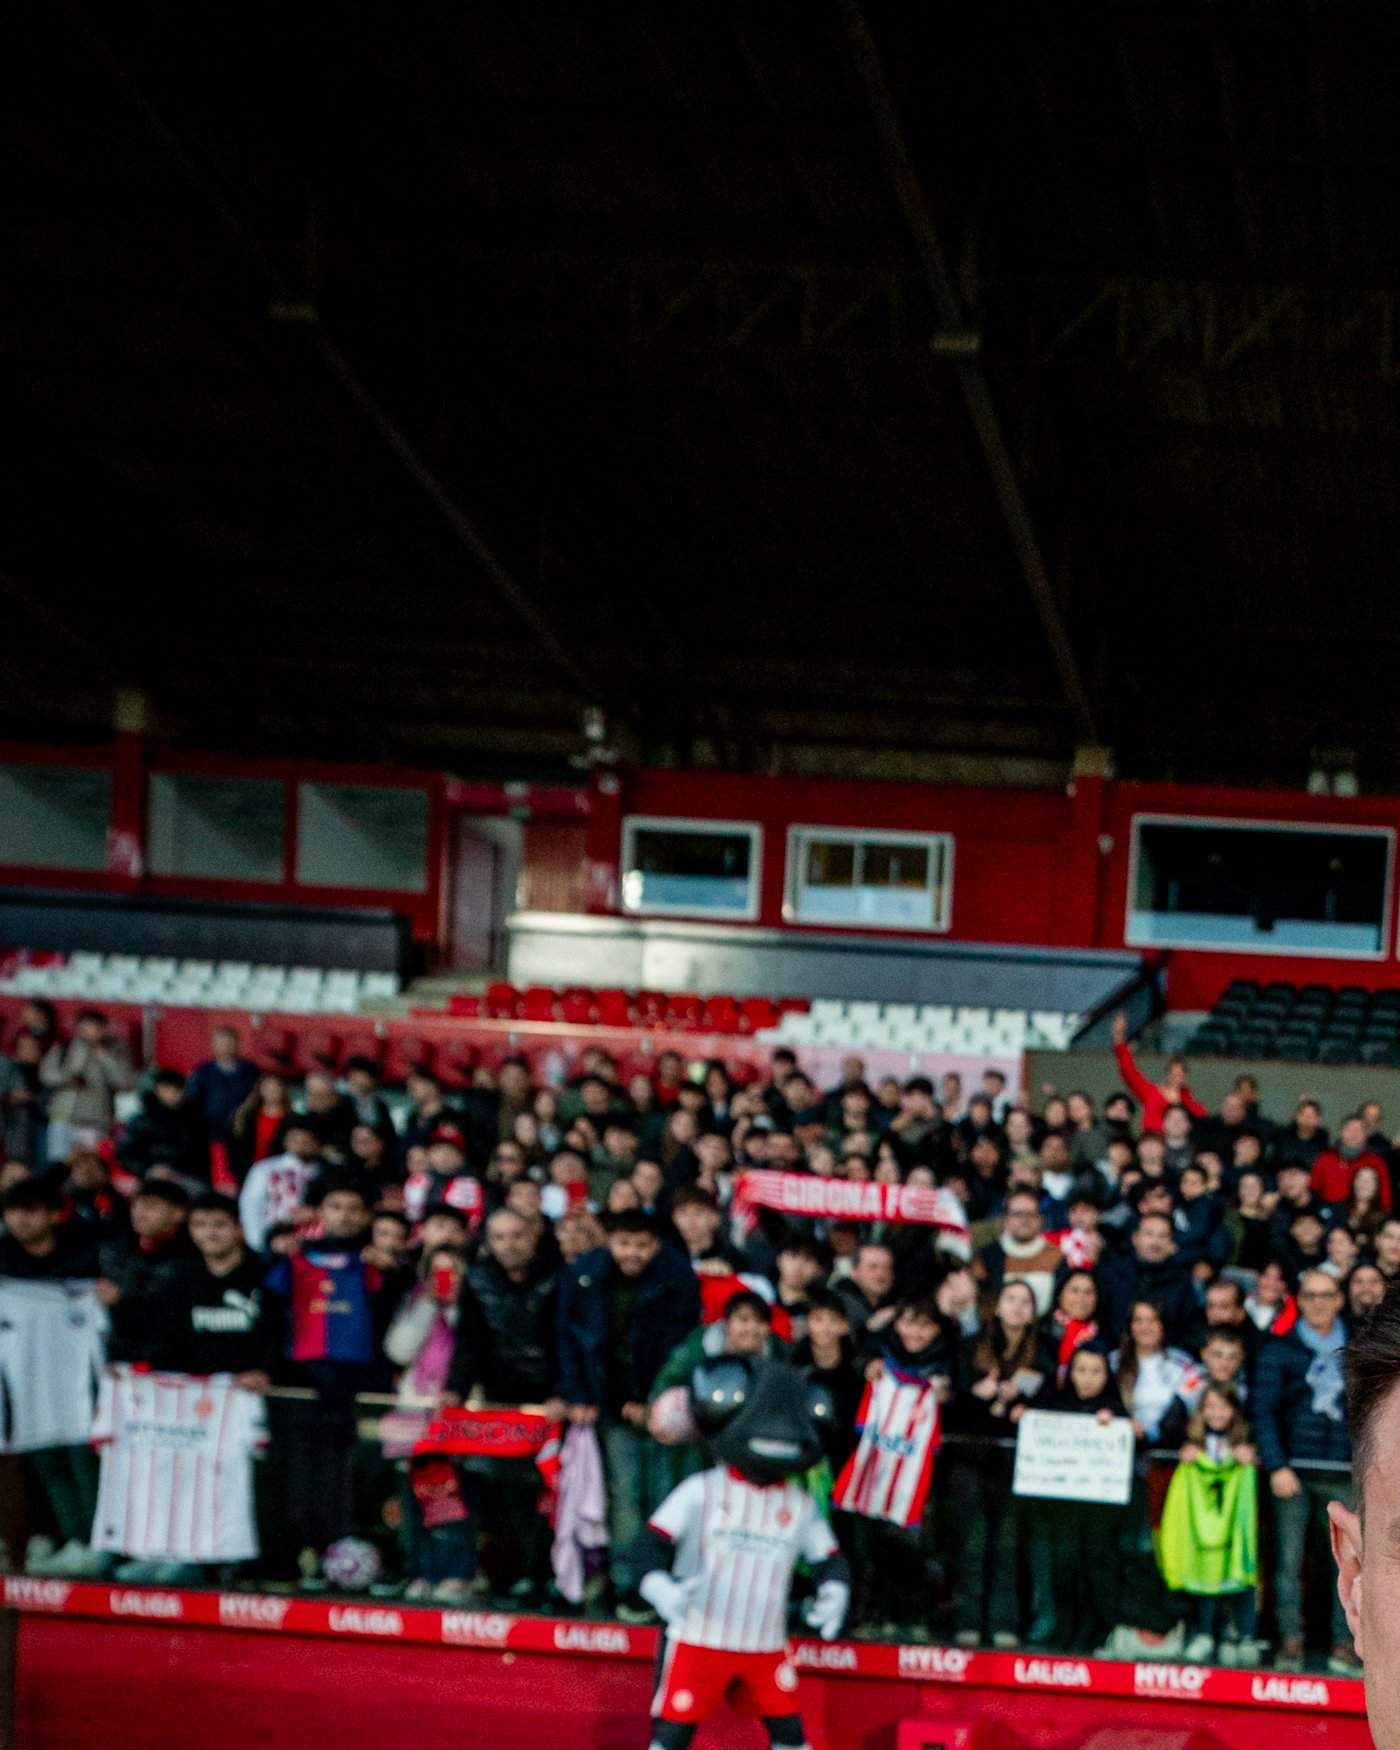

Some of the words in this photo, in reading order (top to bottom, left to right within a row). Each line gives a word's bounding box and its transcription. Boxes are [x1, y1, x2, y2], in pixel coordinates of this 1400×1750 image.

[784, 1175, 881, 1218] GIRONA
[898, 1645, 970, 1673] HYLO
[1013, 1658, 1091, 1687] LALIGA
[1134, 1663, 1205, 1691] HYLO
[1251, 1675, 1329, 1706] LALIGA
